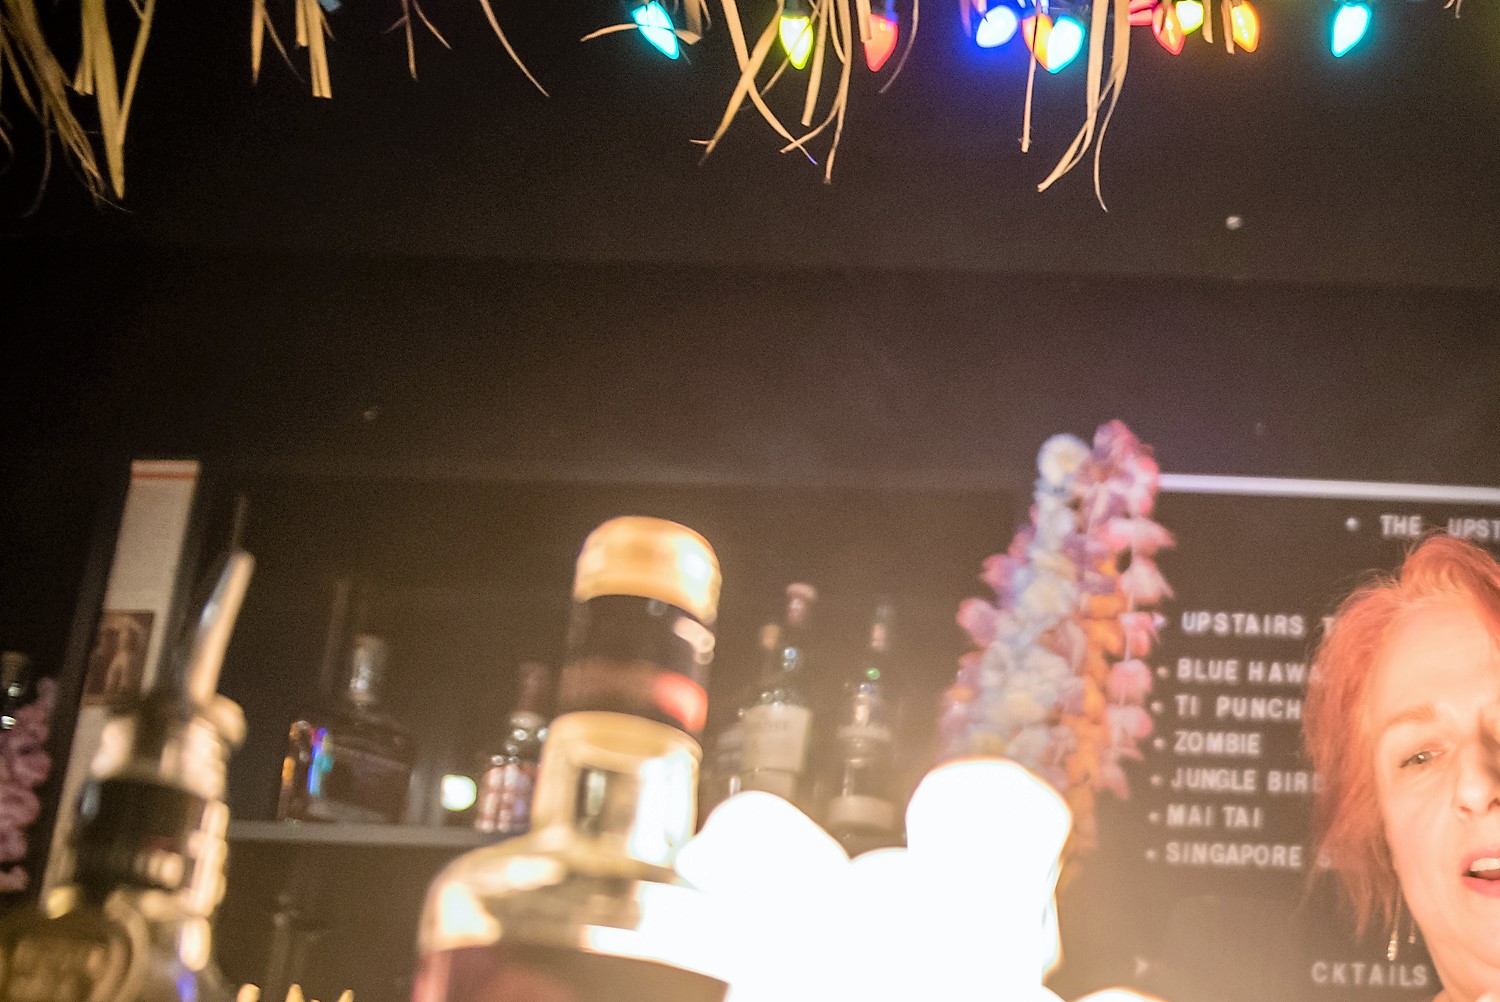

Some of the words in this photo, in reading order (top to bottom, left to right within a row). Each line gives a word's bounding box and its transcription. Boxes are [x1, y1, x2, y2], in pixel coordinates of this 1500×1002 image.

[1380, 514, 1422, 536] THE
[1182, 612, 1304, 637] UPSTAIRS
[1177, 659, 1238, 682] BLUE
[1175, 695, 1197, 717] TI
[1217, 697, 1302, 720] PUNCH
[1175, 731, 1261, 755] ZOMBIE
[1171, 768, 1255, 791] JUNGLE
[1167, 805, 1211, 826] MAI
[1223, 807, 1261, 829] TAI
[1166, 843, 1302, 867] SINGAPORE
